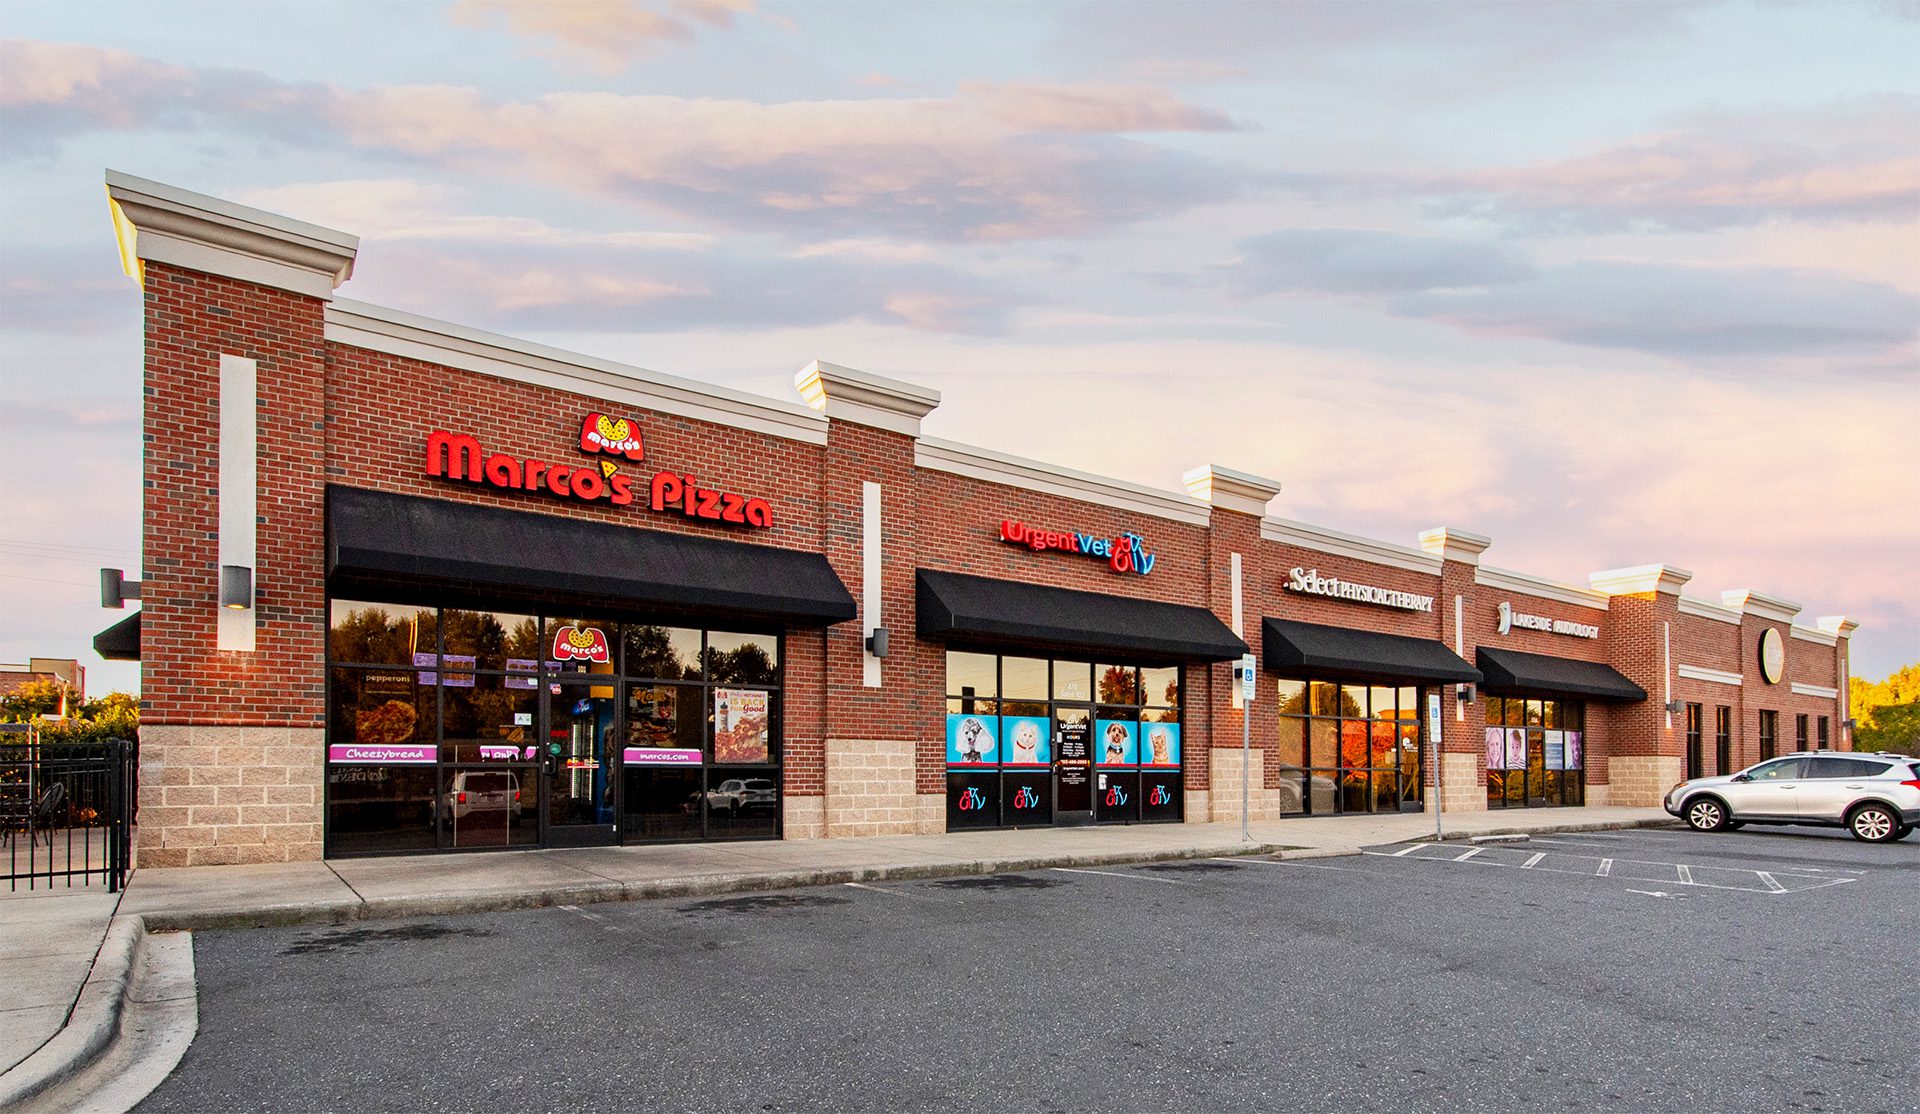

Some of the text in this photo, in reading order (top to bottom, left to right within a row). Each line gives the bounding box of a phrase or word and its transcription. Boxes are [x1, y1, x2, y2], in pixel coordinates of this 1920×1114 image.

[1289, 567, 1433, 612] Select PHYSICAL THERAPY
[1512, 612, 1599, 639] LAKESIDE AUDIOLOGY
[366, 674, 410, 683] pepperoni
[743, 704, 765, 714] Good
[346, 748, 424, 760] Cheezybread
